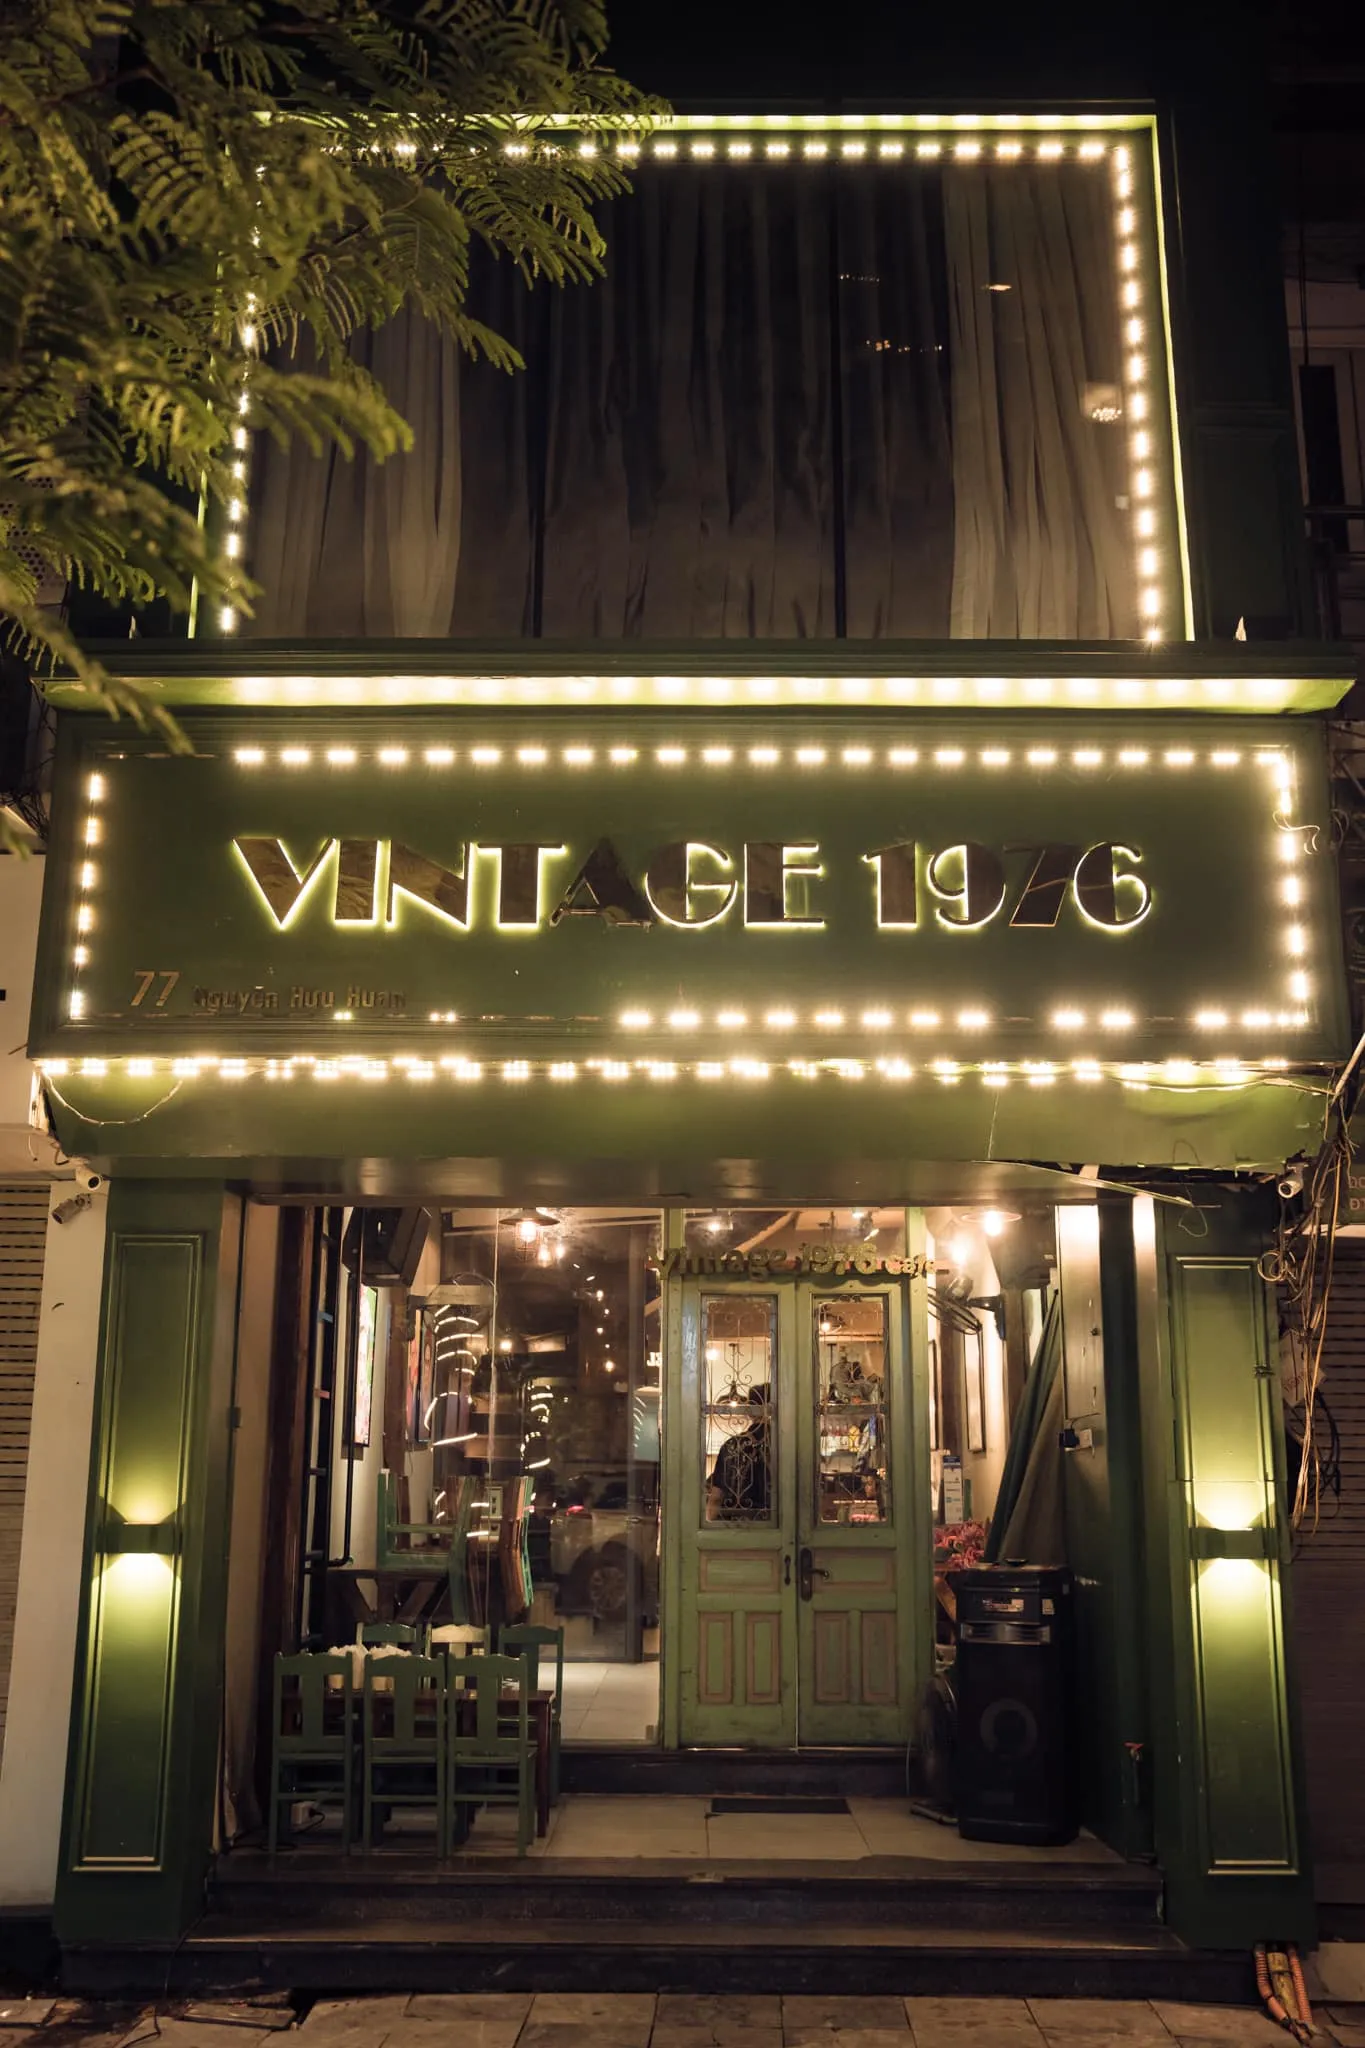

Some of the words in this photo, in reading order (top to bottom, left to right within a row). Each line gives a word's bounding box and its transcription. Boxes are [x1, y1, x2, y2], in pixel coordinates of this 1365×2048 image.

[231, 837, 826, 930] VINTAGE
[862, 840, 1152, 932] 1976
[129, 970, 182, 1007] 77
[797, 1242, 878, 1275] 1976
